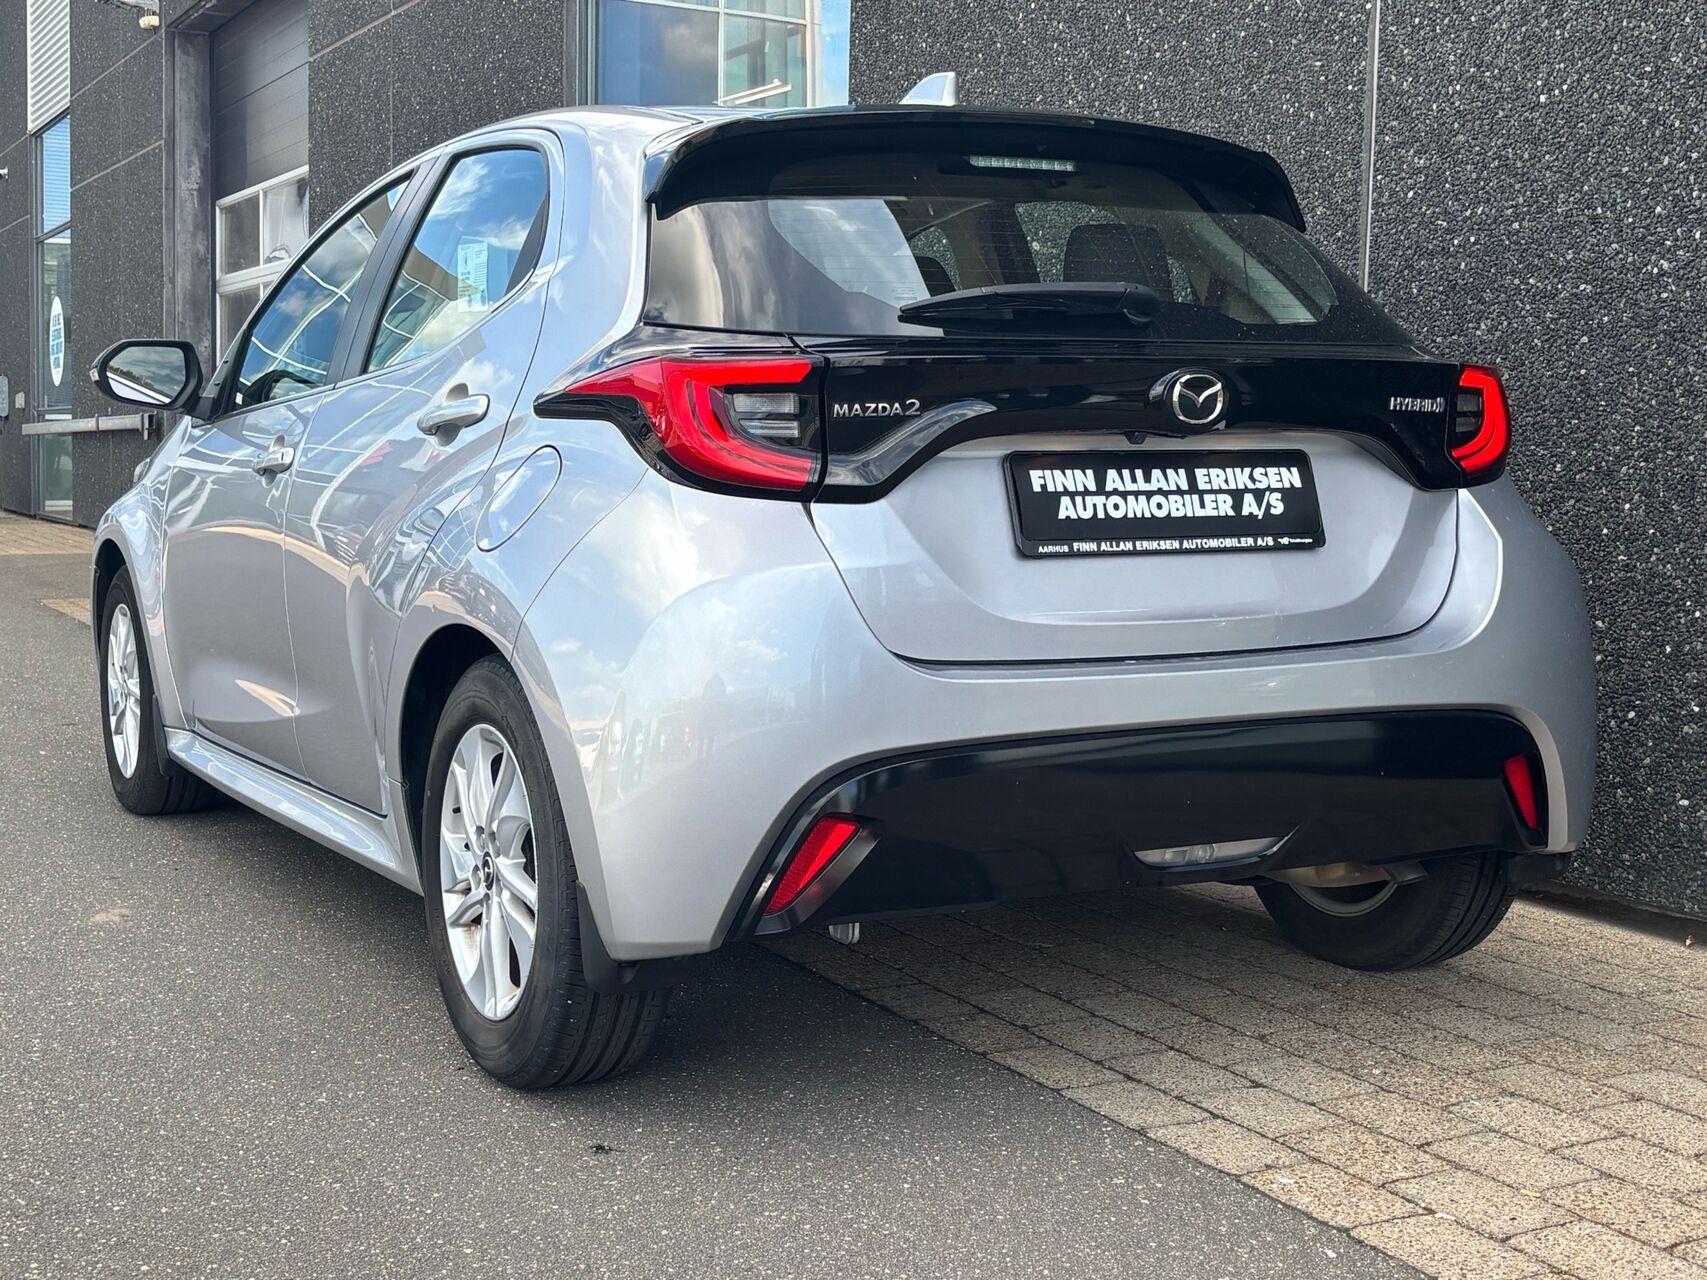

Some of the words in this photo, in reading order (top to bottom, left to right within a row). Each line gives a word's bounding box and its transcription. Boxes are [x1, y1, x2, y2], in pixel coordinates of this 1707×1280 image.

[1390, 397, 1437, 412] HYBRID
[1029, 469, 1097, 492] FINN
[1105, 468, 1189, 492] ALLAN
[1194, 466, 1302, 490] ERIKSEN
[1058, 493, 1235, 519] AUTOMOBILER
[1241, 491, 1284, 519] A/S
[1038, 545, 1069, 553] AARHUS
[1073, 541, 1098, 552] FINN
[1100, 541, 1133, 551] ALLAN
[1136, 539, 1179, 550] ERIKSEN
[1182, 537, 1254, 549] AUTOMOBILER
[1257, 536, 1274, 546] A/S
